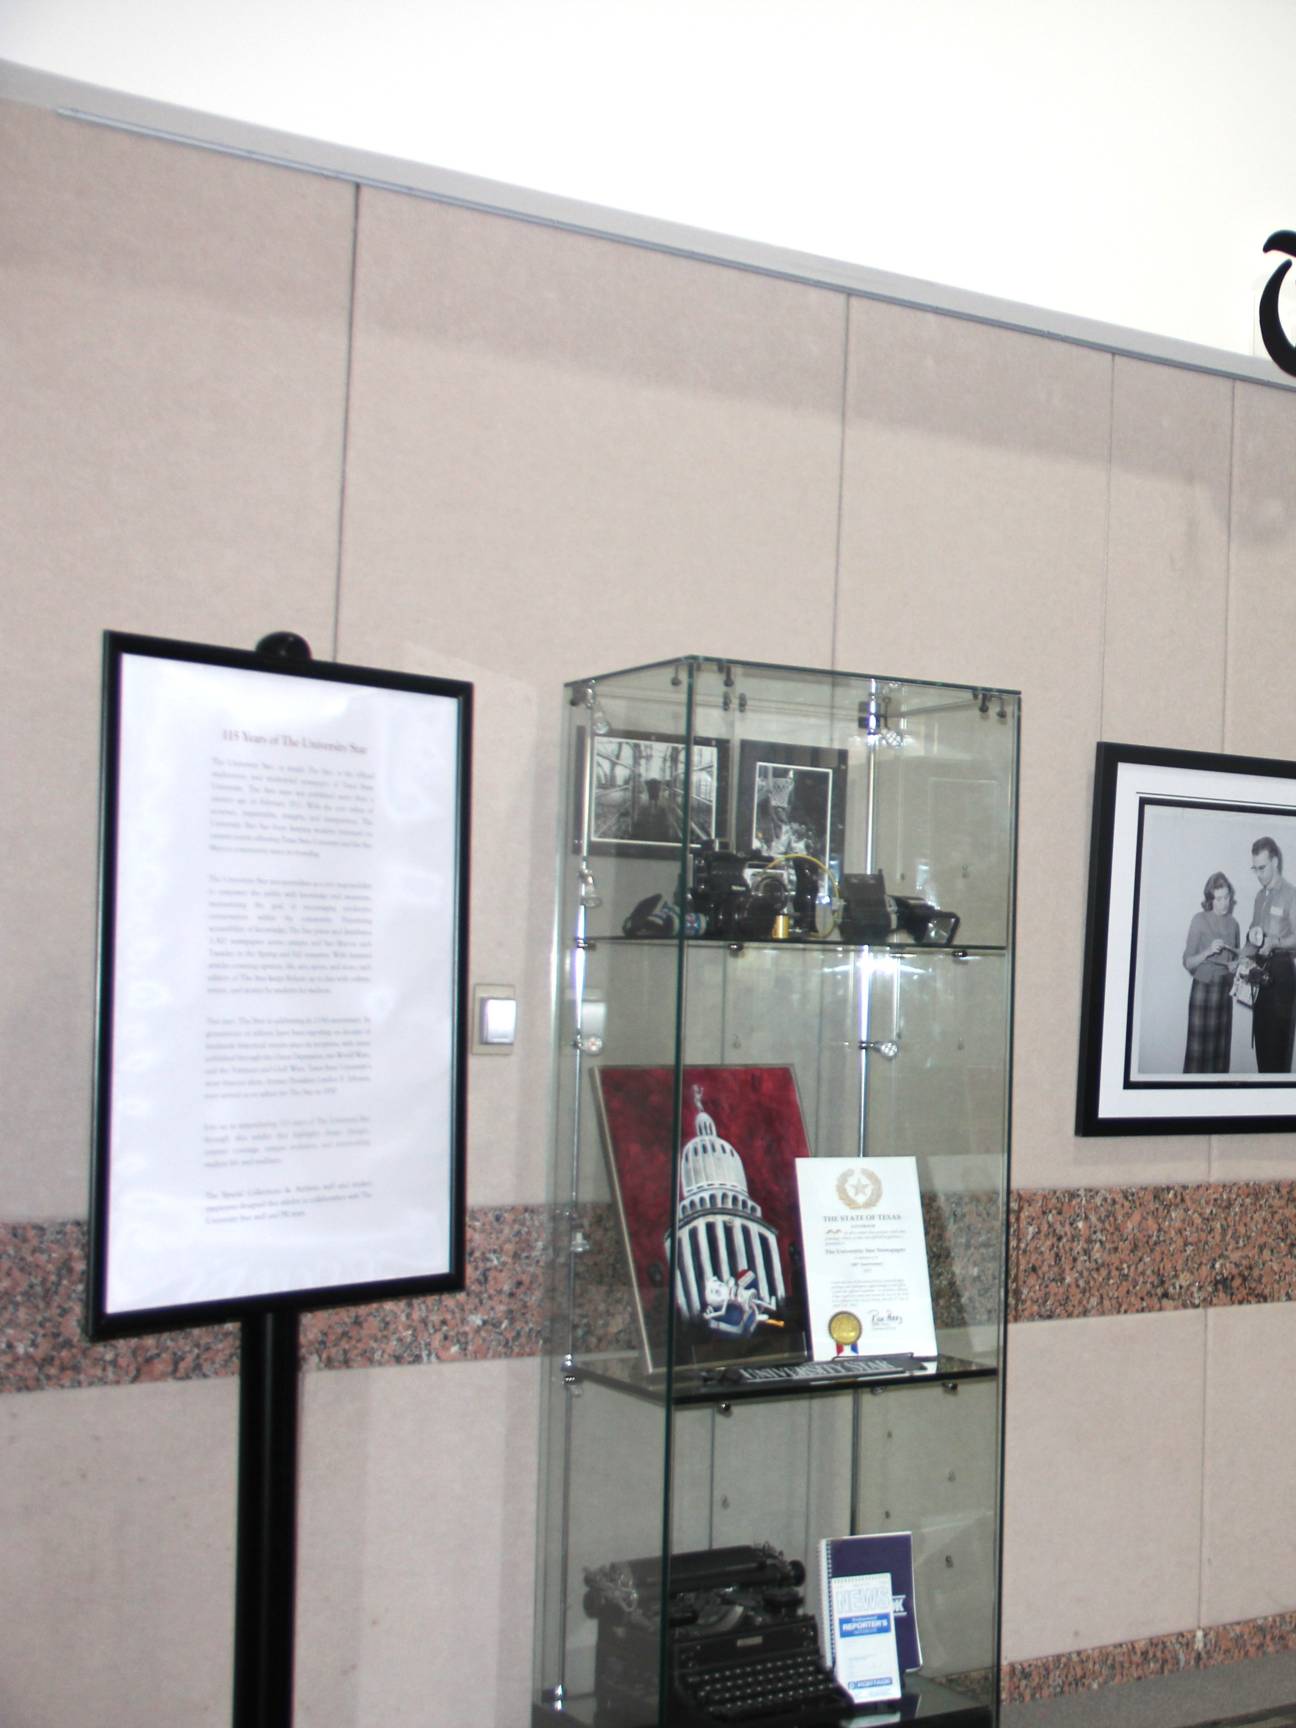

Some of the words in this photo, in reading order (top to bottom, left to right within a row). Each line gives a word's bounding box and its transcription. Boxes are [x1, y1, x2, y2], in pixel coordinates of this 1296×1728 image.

[270, 733, 279, 745] of
[280, 735, 299, 748] The
[302, 737, 347, 753] University
[824, 1215, 837, 1223] THE
[840, 1214, 864, 1222] STATE
[865, 1214, 876, 1222] OF
[878, 1213, 902, 1221] TEXAS
[739, 1360, 847, 1380] UNIVERSITY
[848, 1358, 896, 1373] STAR
[836, 1586, 891, 1613] NEWS
